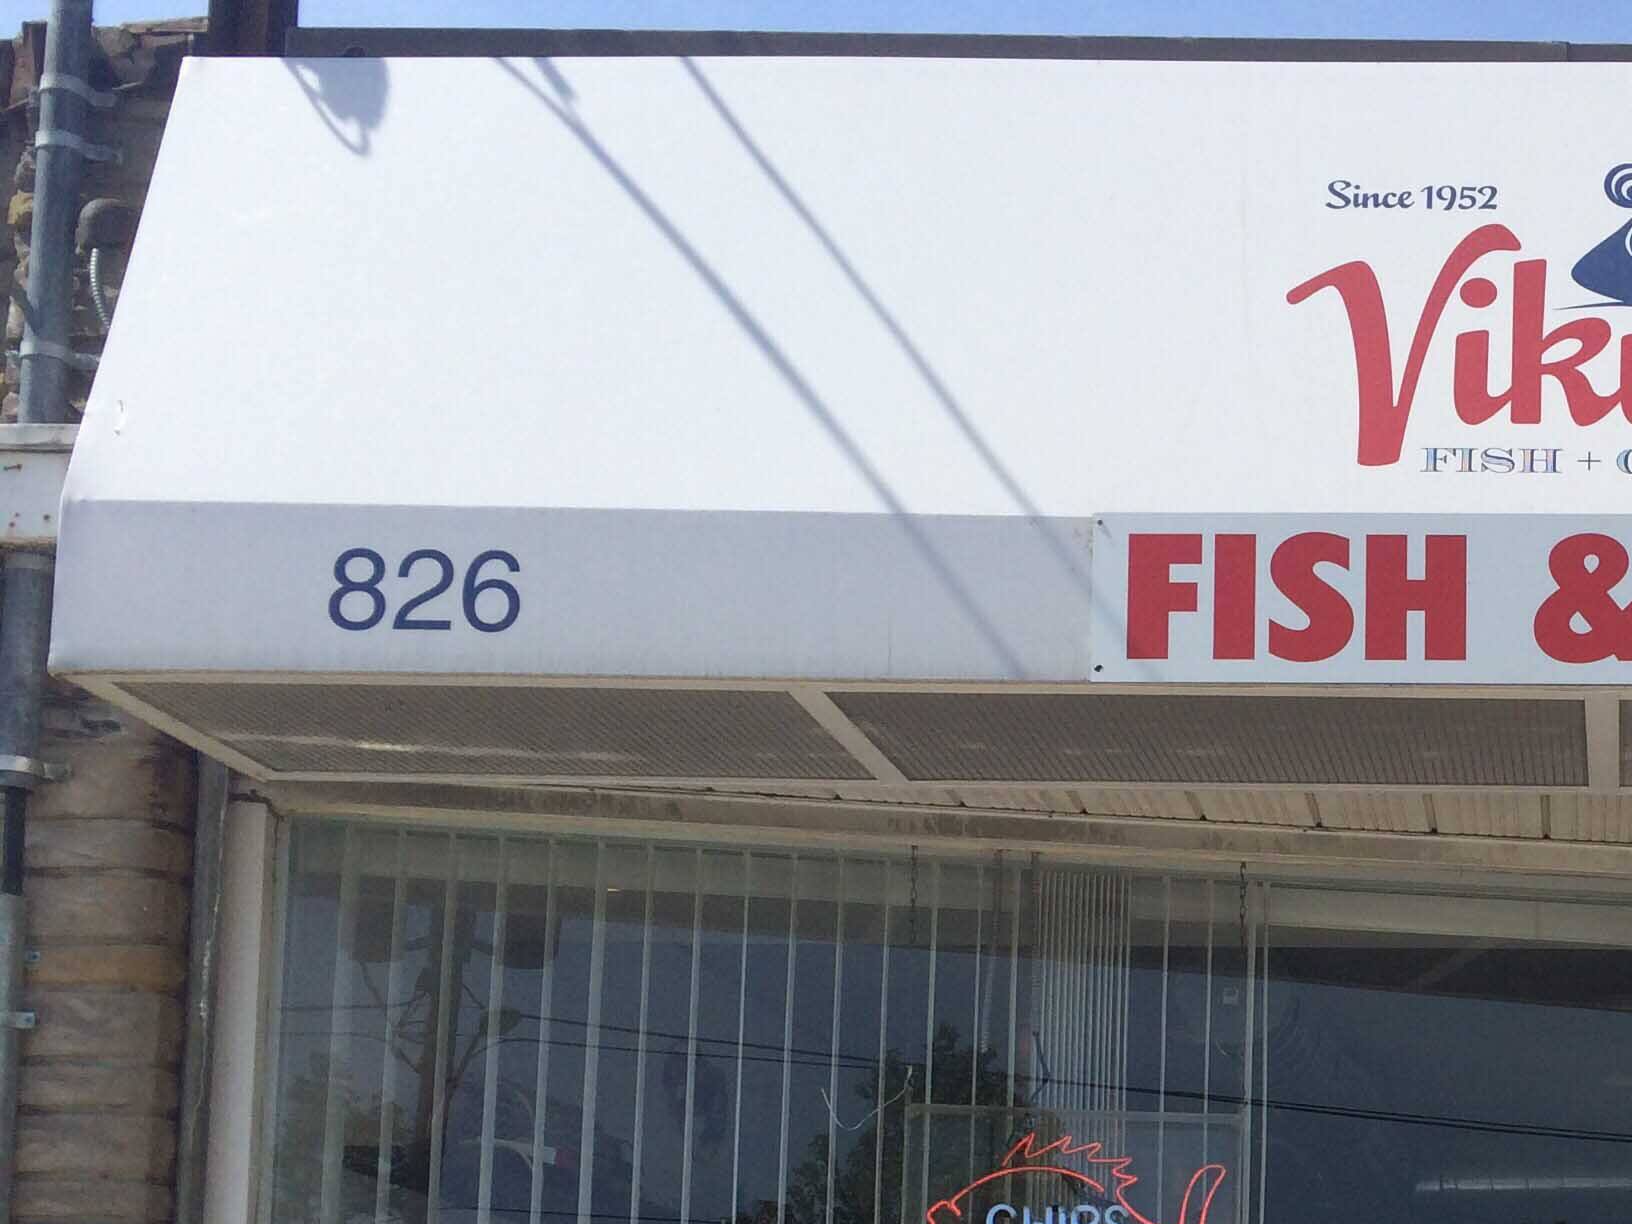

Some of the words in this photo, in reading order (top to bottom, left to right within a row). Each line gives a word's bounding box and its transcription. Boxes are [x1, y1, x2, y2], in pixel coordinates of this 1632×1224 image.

[1326, 179, 1415, 211] Since
[1421, 183, 1499, 212] 1952
[1419, 446, 1563, 474] FISH
[328, 547, 521, 633] 826
[1126, 532, 1467, 662] FISH
